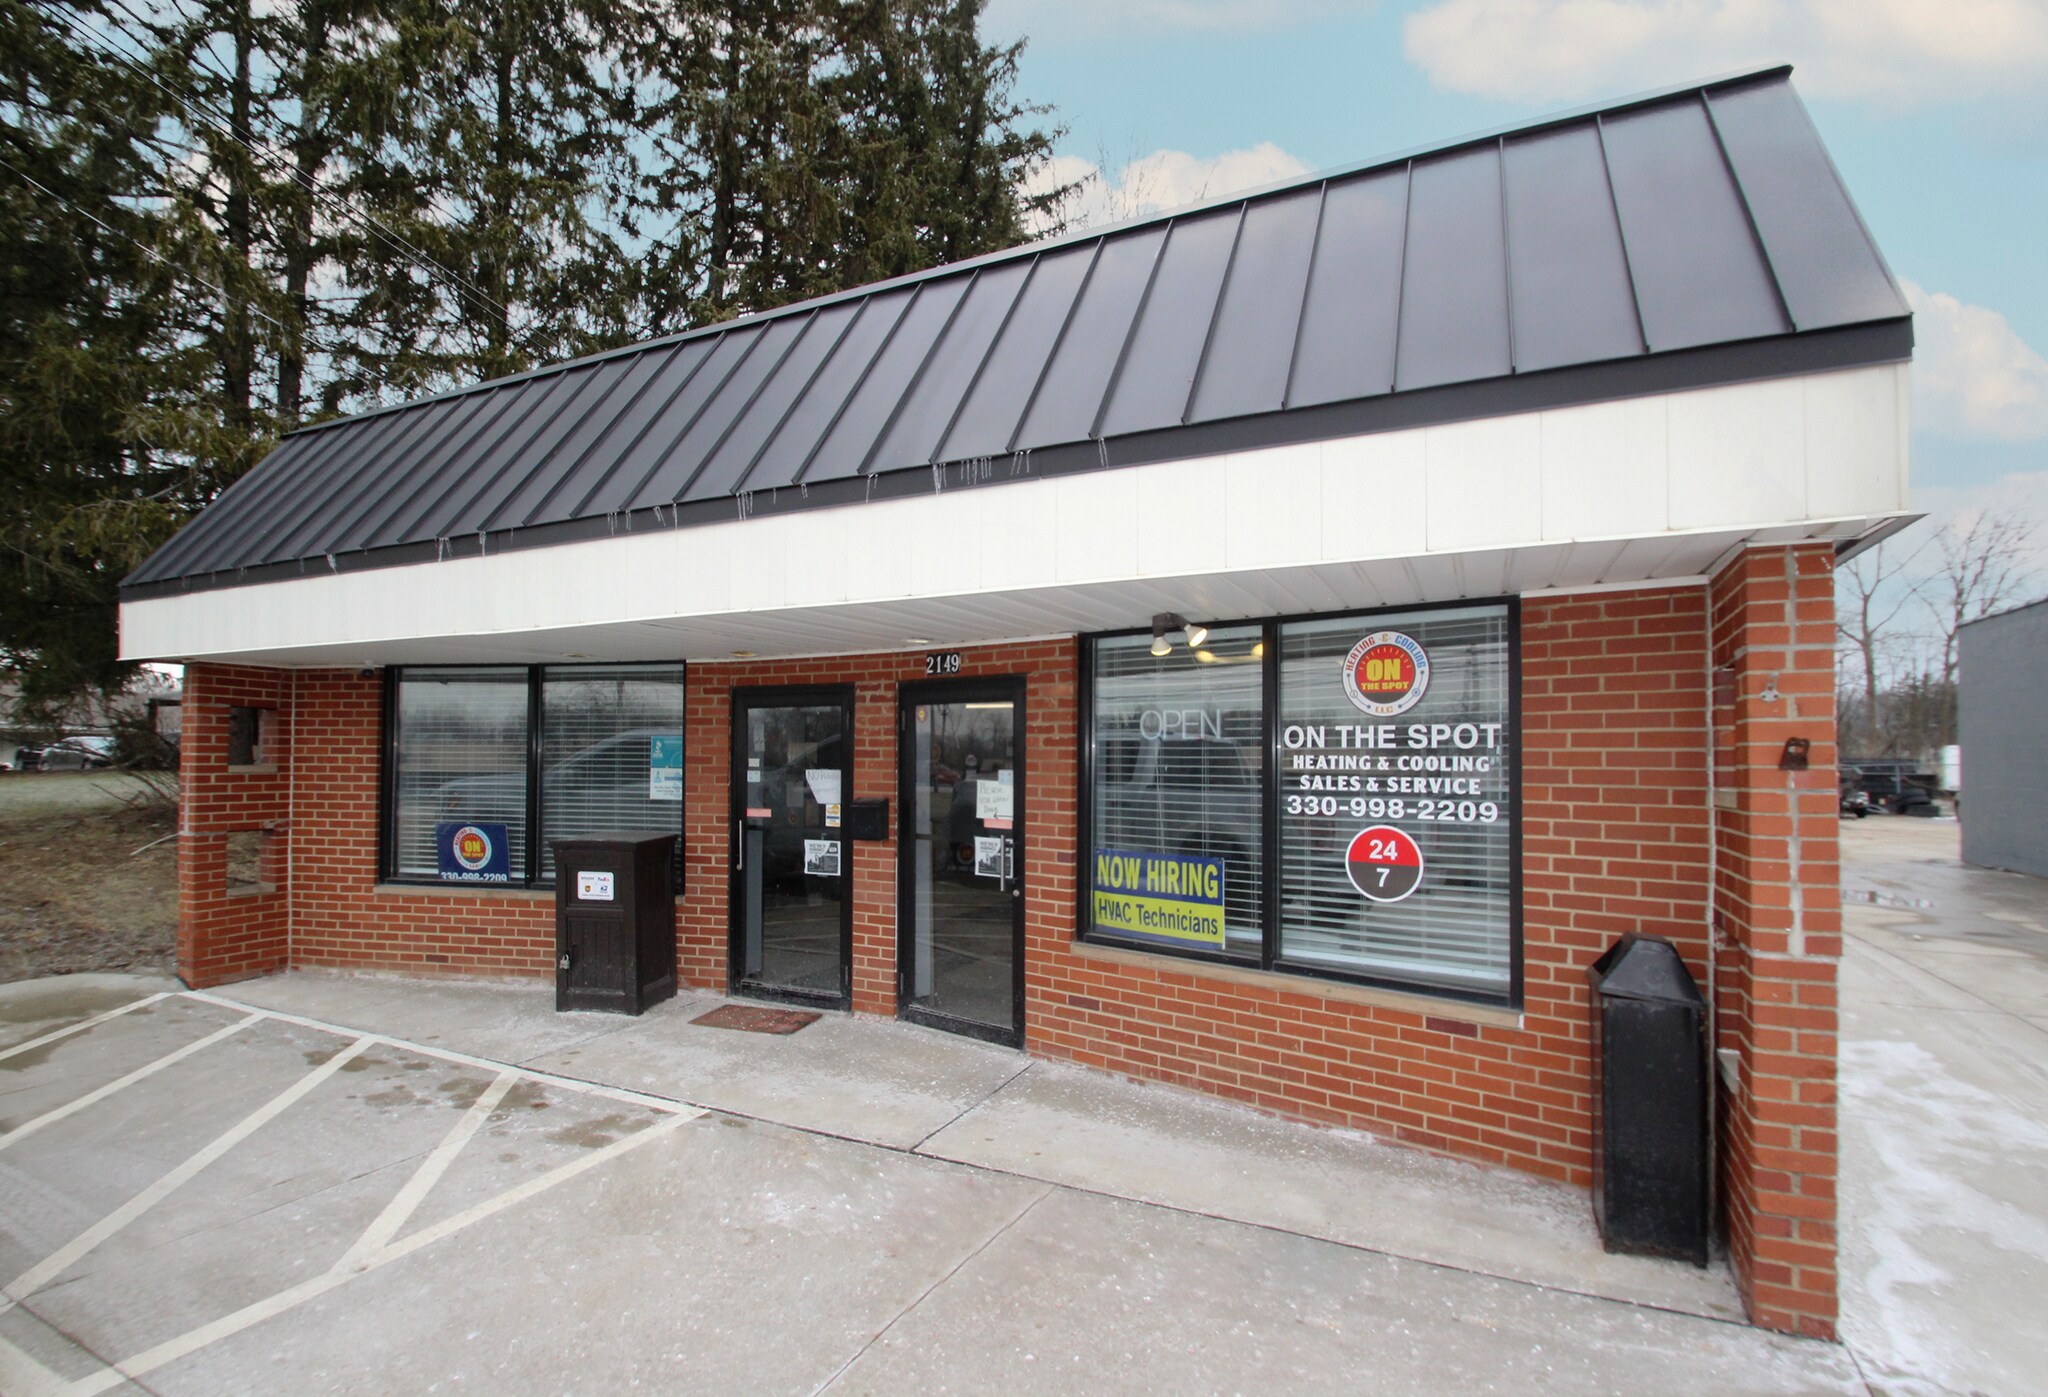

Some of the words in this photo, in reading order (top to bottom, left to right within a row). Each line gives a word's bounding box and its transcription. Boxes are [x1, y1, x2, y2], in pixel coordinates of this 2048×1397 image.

[1345, 636, 1376, 671] HEATING
[1394, 635, 1427, 669] COOLING
[926, 654, 960, 674] 2149
[1366, 658, 1402, 682] ON
[1361, 682, 1380, 691] THE
[1381, 681, 1409, 690] SPOT
[1375, 706, 1394, 714] LLC
[1140, 709, 1222, 740] OPEN
[1284, 725, 1325, 750] ON
[1335, 725, 1397, 749] THE
[1407, 723, 1502, 749] SPOT
[1293, 755, 1371, 771] HEATING
[1377, 756, 1389, 771] &
[1398, 755, 1490, 772] COOLING
[1300, 775, 1361, 791] SALES
[1366, 777, 1379, 792] &
[1387, 777, 1481, 795] SERVICE
[1287, 795, 1498, 823] 330-998-2209
[464, 840, 481, 853] ON
[1369, 839, 1398, 860] 24
[1097, 855, 1141, 890] NOW
[1147, 859, 1219, 899] HIRING
[1376, 868, 1390, 887] 7
[1099, 898, 1132, 923] HVAC
[1136, 904, 1218, 935] Technicians
